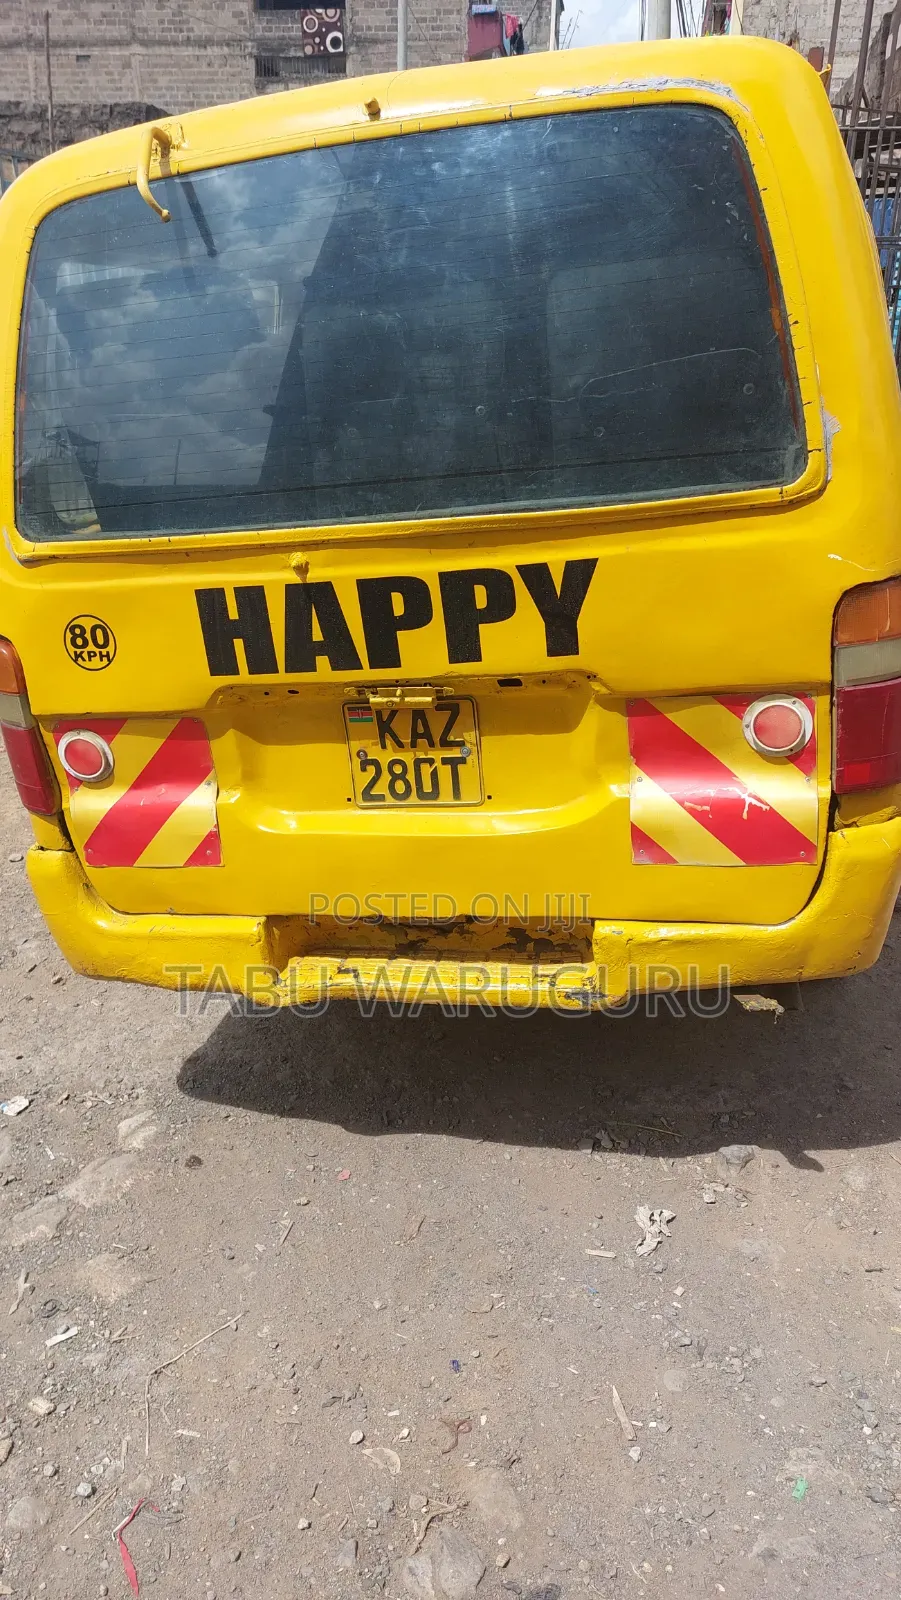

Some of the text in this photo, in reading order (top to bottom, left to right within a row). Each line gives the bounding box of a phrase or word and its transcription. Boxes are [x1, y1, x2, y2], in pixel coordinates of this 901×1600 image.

[69, 623, 110, 650] 80
[194, 557, 599, 677] HAPPY
[73, 650, 111, 662] KPH
[375, 703, 466, 750] KAZ
[360, 756, 468, 802] 280T
